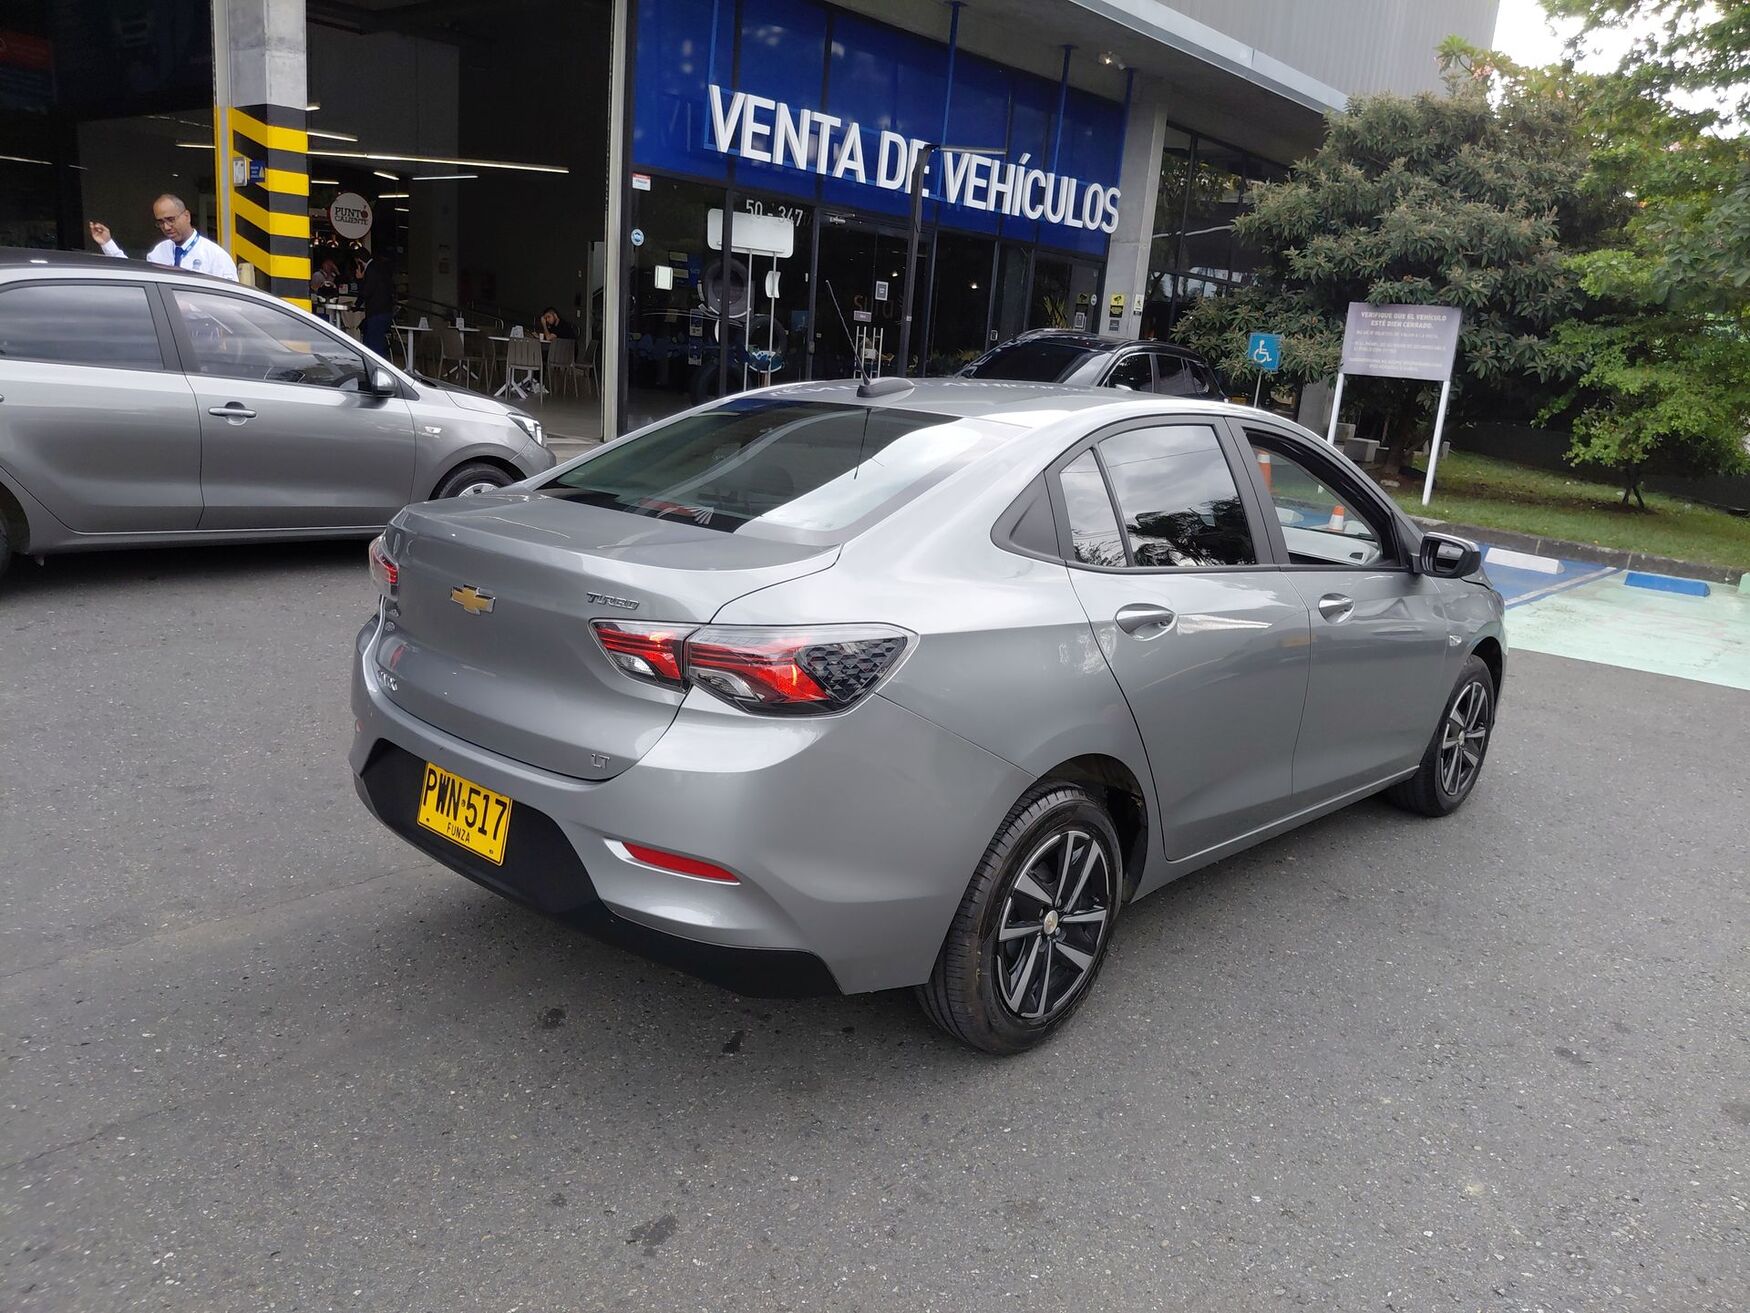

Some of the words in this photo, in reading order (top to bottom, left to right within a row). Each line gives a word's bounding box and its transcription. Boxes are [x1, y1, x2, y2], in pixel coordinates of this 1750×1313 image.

[708, 84, 867, 183] VENTA
[942, 152, 1122, 234] VEHÍCULOS
[335, 216, 368, 225] CALIENTE
[746, 199, 763, 219] 50
[778, 206, 804, 227] 347
[1360, 311, 1392, 319] VERIFIQUE
[1416, 313, 1447, 321] VEHÍCULO
[1370, 319, 1386, 327] ESTÉ
[587, 591, 640, 610] TURBO
[591, 753, 610, 769] LT
[446, 822, 471, 844] FUNZA
